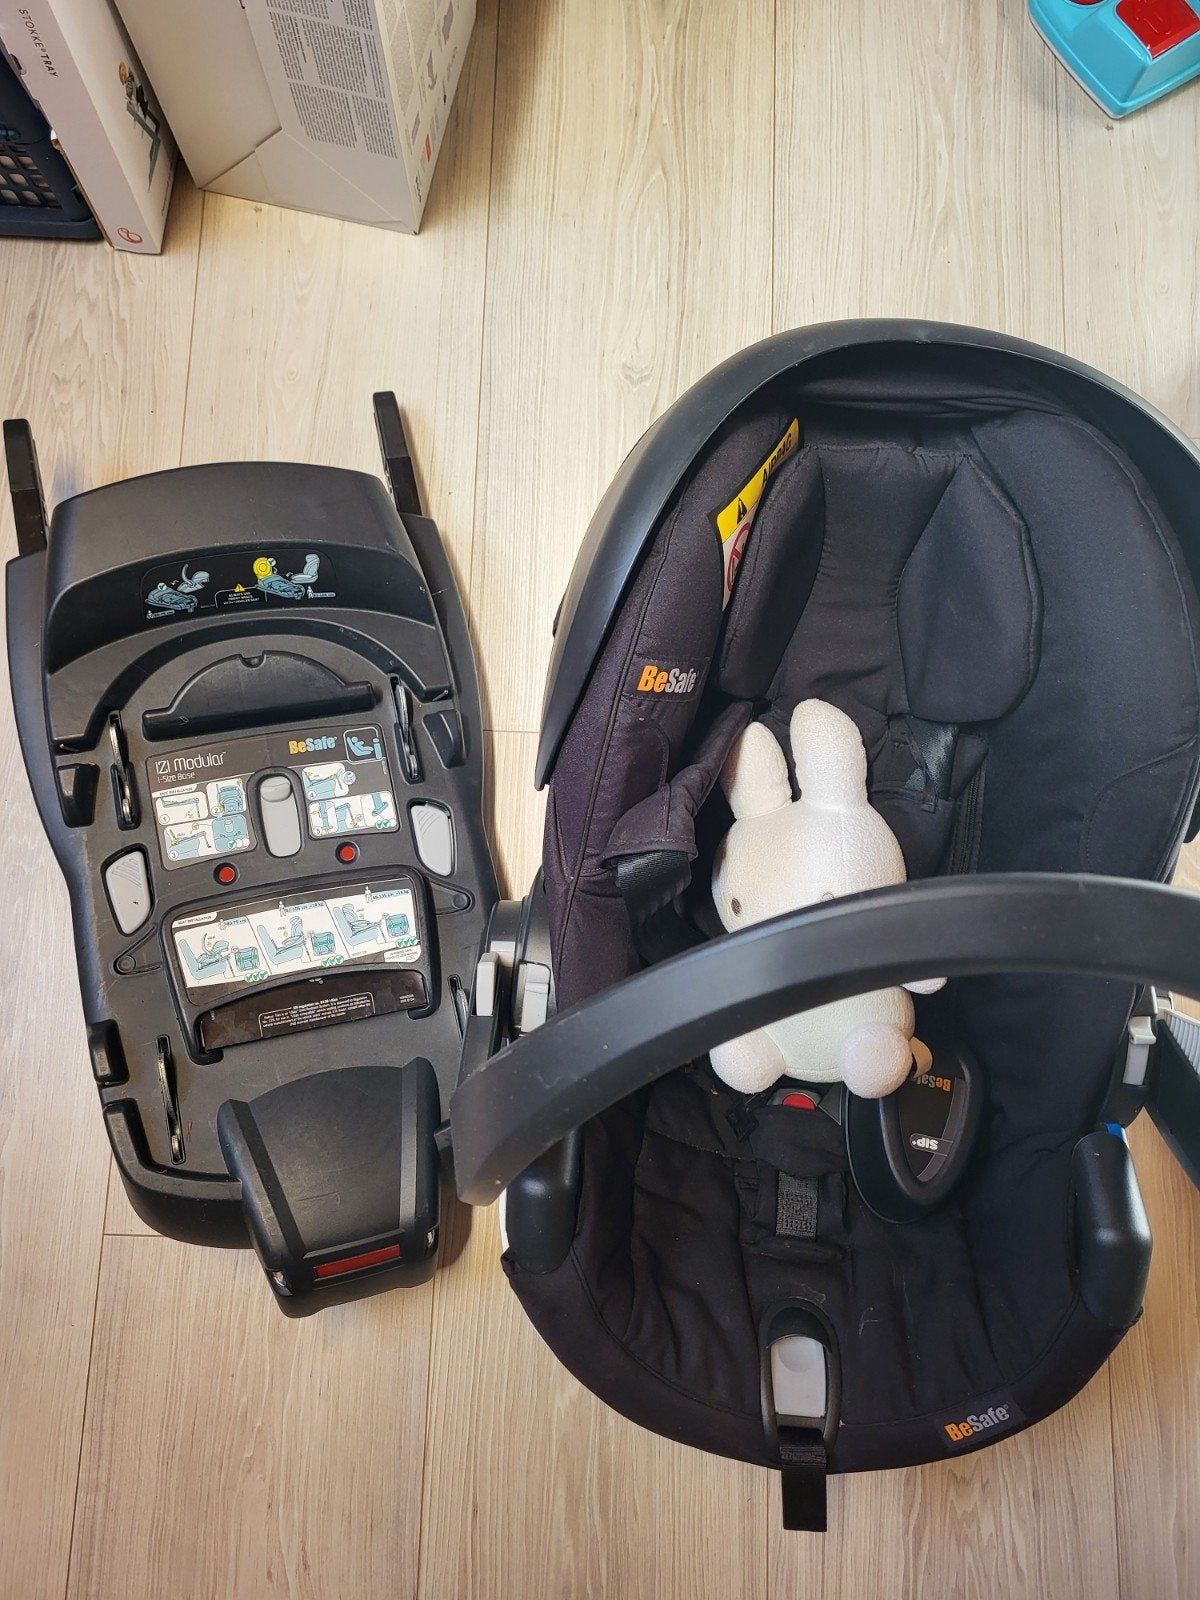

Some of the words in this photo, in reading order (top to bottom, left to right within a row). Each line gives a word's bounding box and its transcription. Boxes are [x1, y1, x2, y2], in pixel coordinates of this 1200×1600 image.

[41, 54, 59, 77] TRAY
[637, 665, 697, 693] BeSafe
[288, 736, 336, 755] BeSafe
[173, 752, 225, 772] Modular
[177, 772, 196, 781] Base
